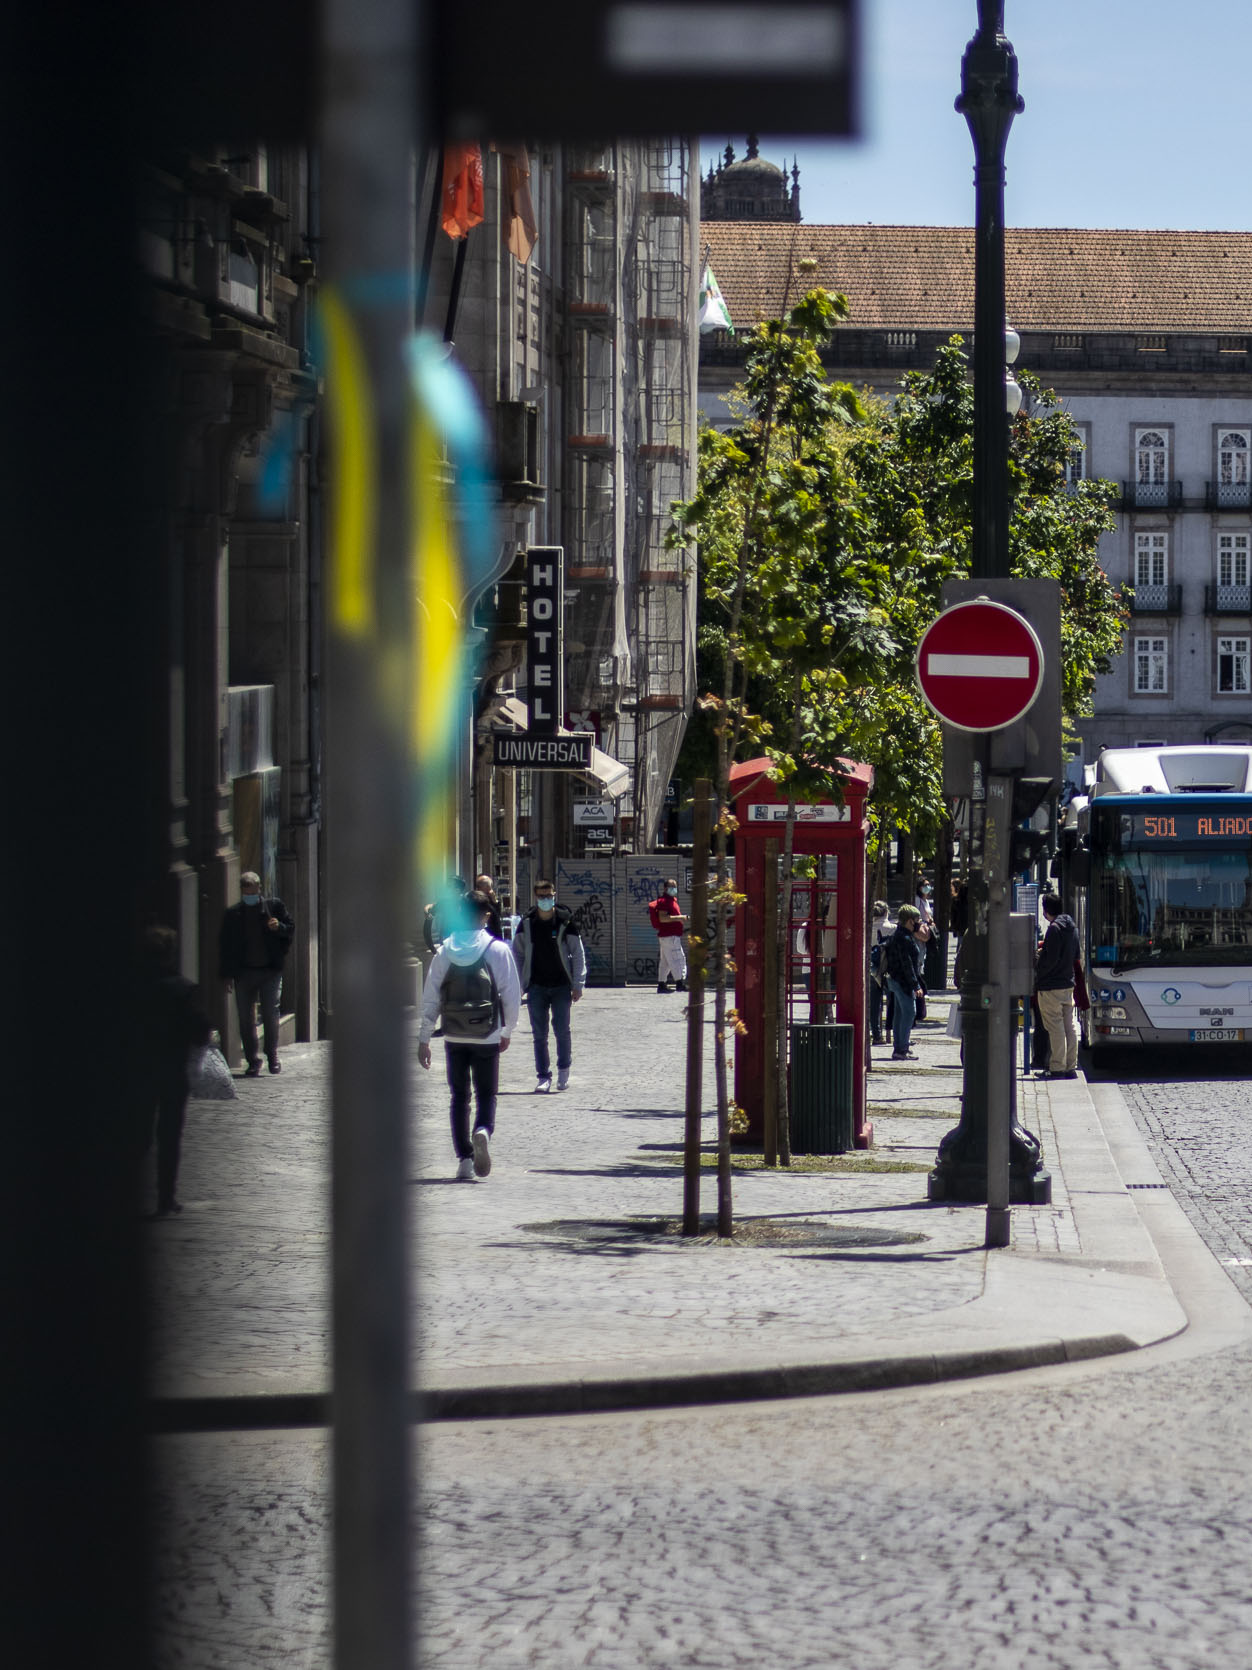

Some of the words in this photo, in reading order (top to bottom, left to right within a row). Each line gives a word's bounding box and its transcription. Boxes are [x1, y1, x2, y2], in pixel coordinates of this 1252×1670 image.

[532, 564, 553, 721] HOTEL
[498, 740, 589, 763] UNIVERSAL
[582, 806, 605, 815] ACA
[1144, 816, 1177, 838] 501
[1199, 1008, 1234, 1016] MAN
